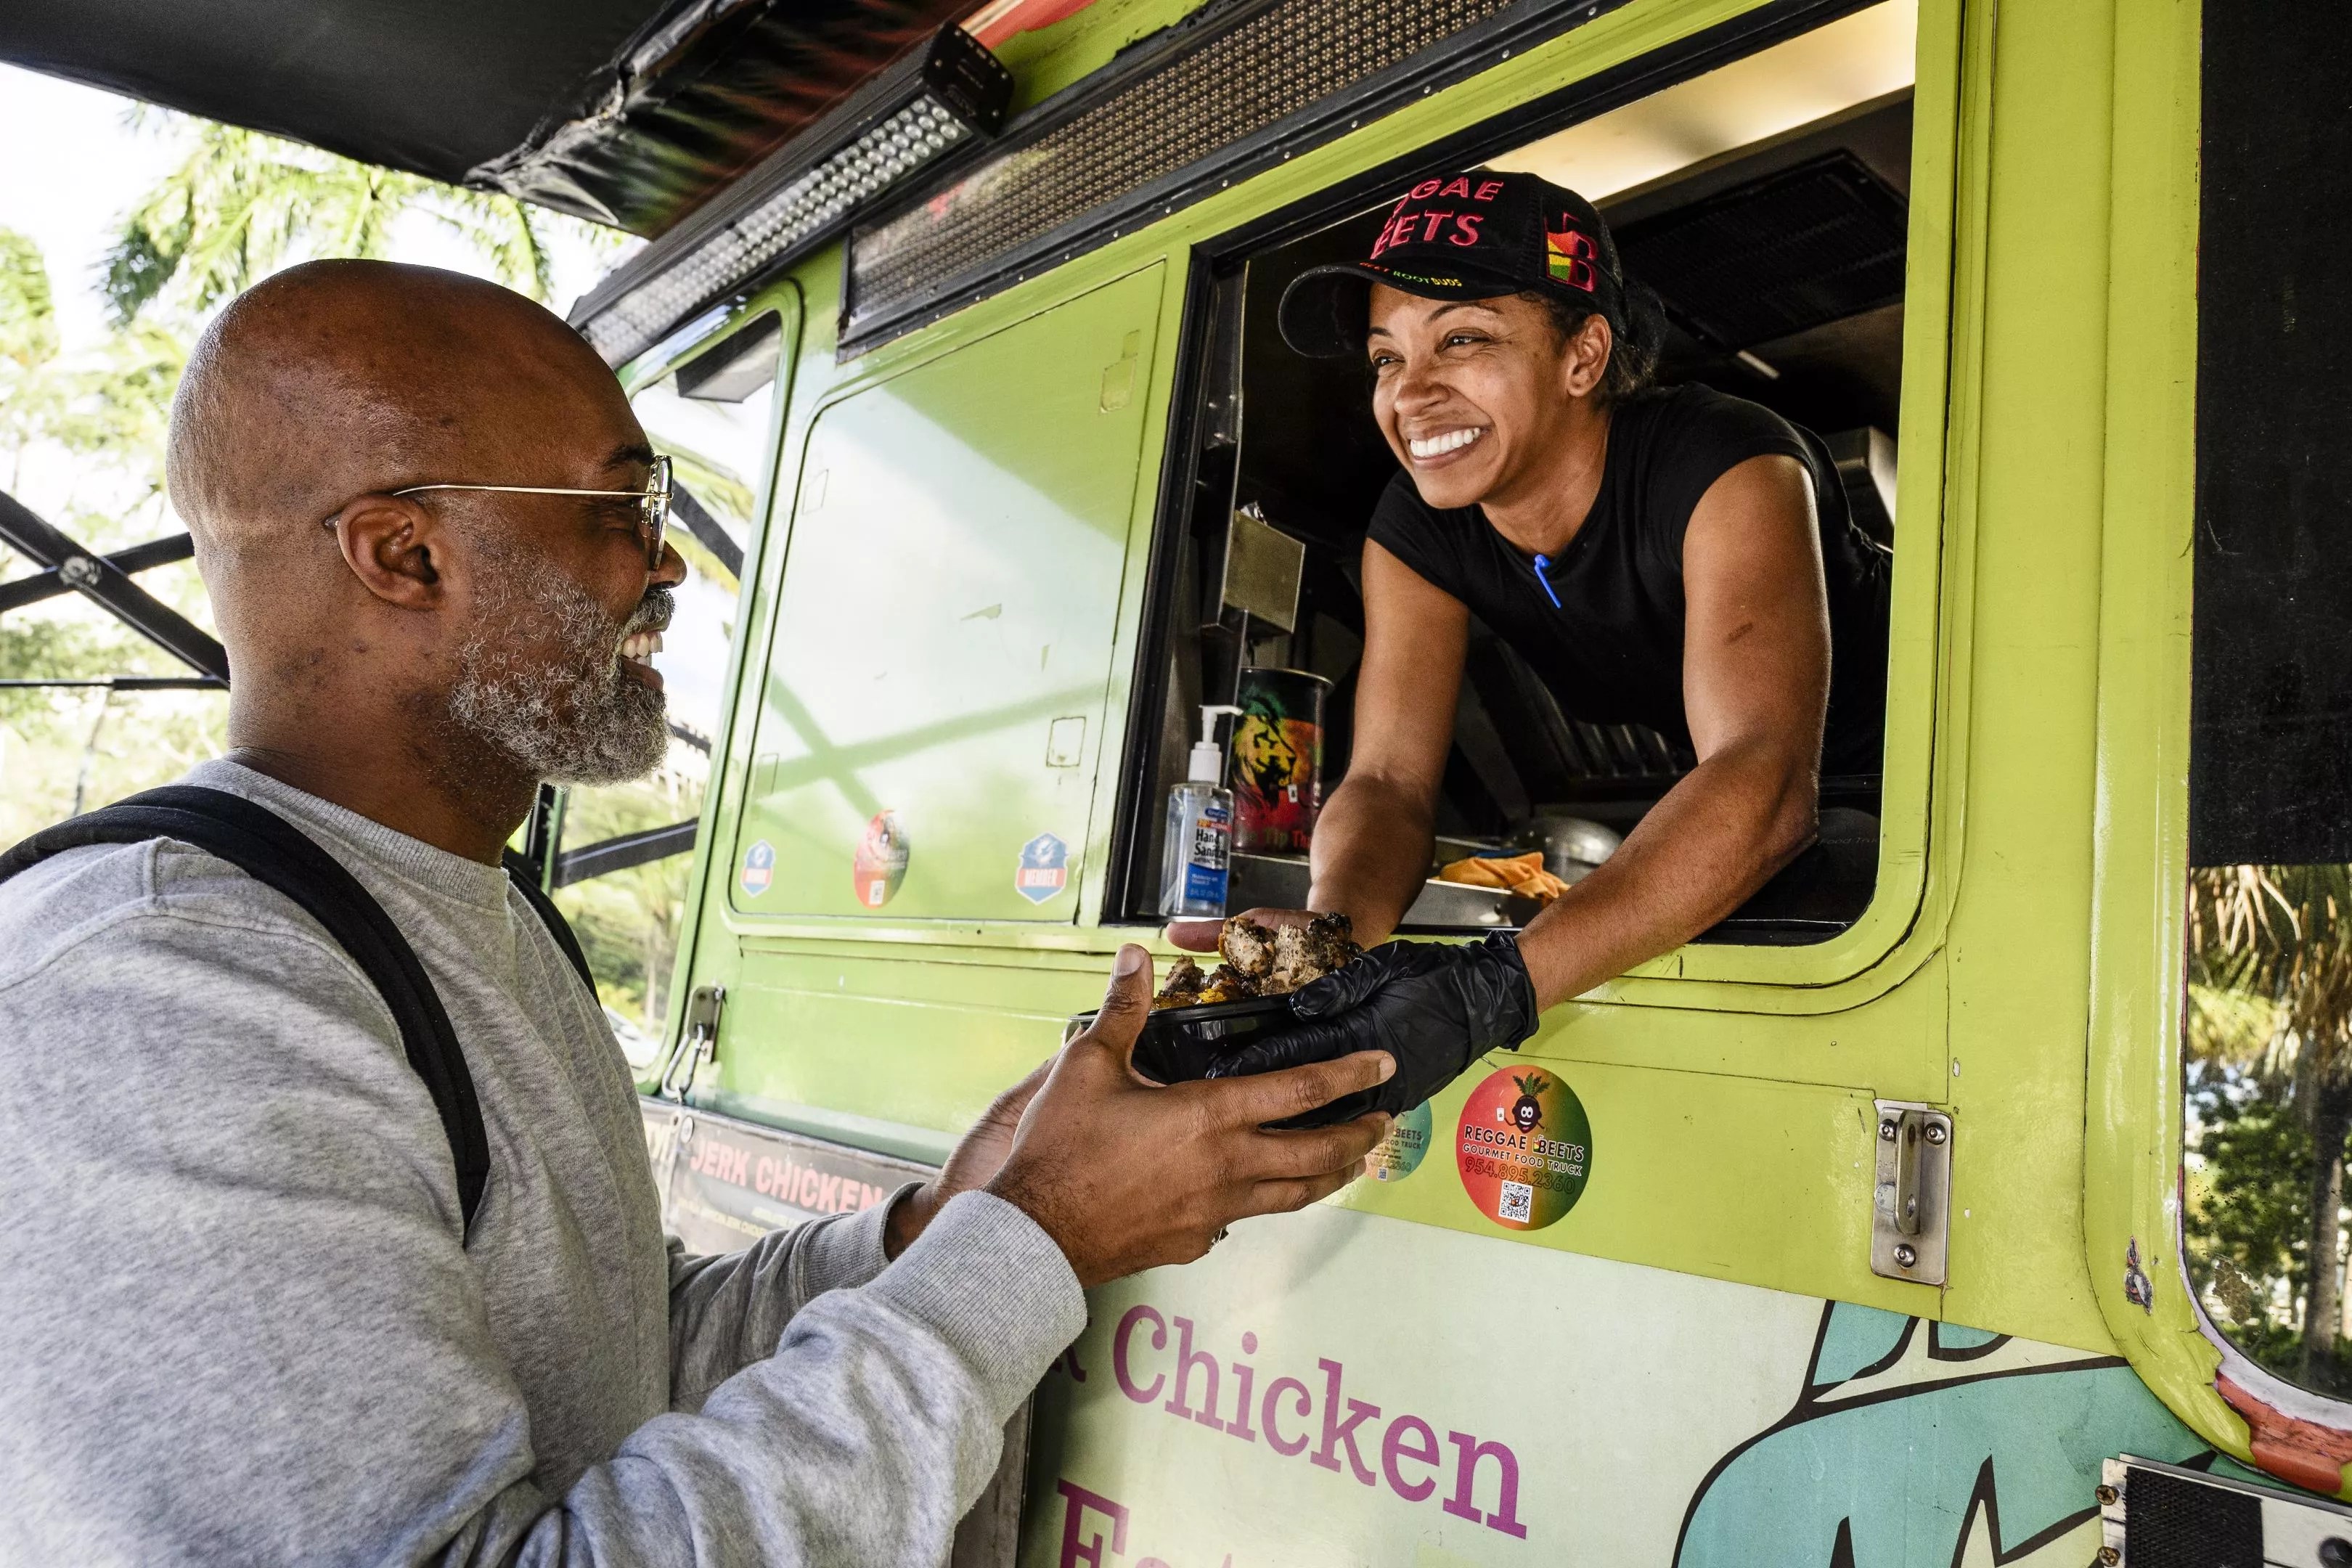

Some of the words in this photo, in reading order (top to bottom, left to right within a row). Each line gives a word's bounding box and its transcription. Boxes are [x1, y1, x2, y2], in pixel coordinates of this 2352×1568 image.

[1371, 209, 1484, 260] EETS
[1430, 277, 1463, 287] BUDS
[1196, 828, 1220, 846] Hand
[1395, 1128, 1422, 1141] BEETS
[1402, 1140, 1421, 1149] TRUCK
[1464, 1125, 1528, 1151] REGGAE
[1533, 1135, 1585, 1162] BEETS
[690, 1139, 751, 1187] JERK
[755, 1156, 883, 1214] CHICKEN
[1463, 1143, 1511, 1161] GOURMET
[1514, 1153, 1544, 1168] FOOD
[1547, 1159, 1583, 1177] TRUCK
[1465, 1156, 1575, 1195] 954.895.2360
[1113, 1304, 1527, 1540] Chicken
